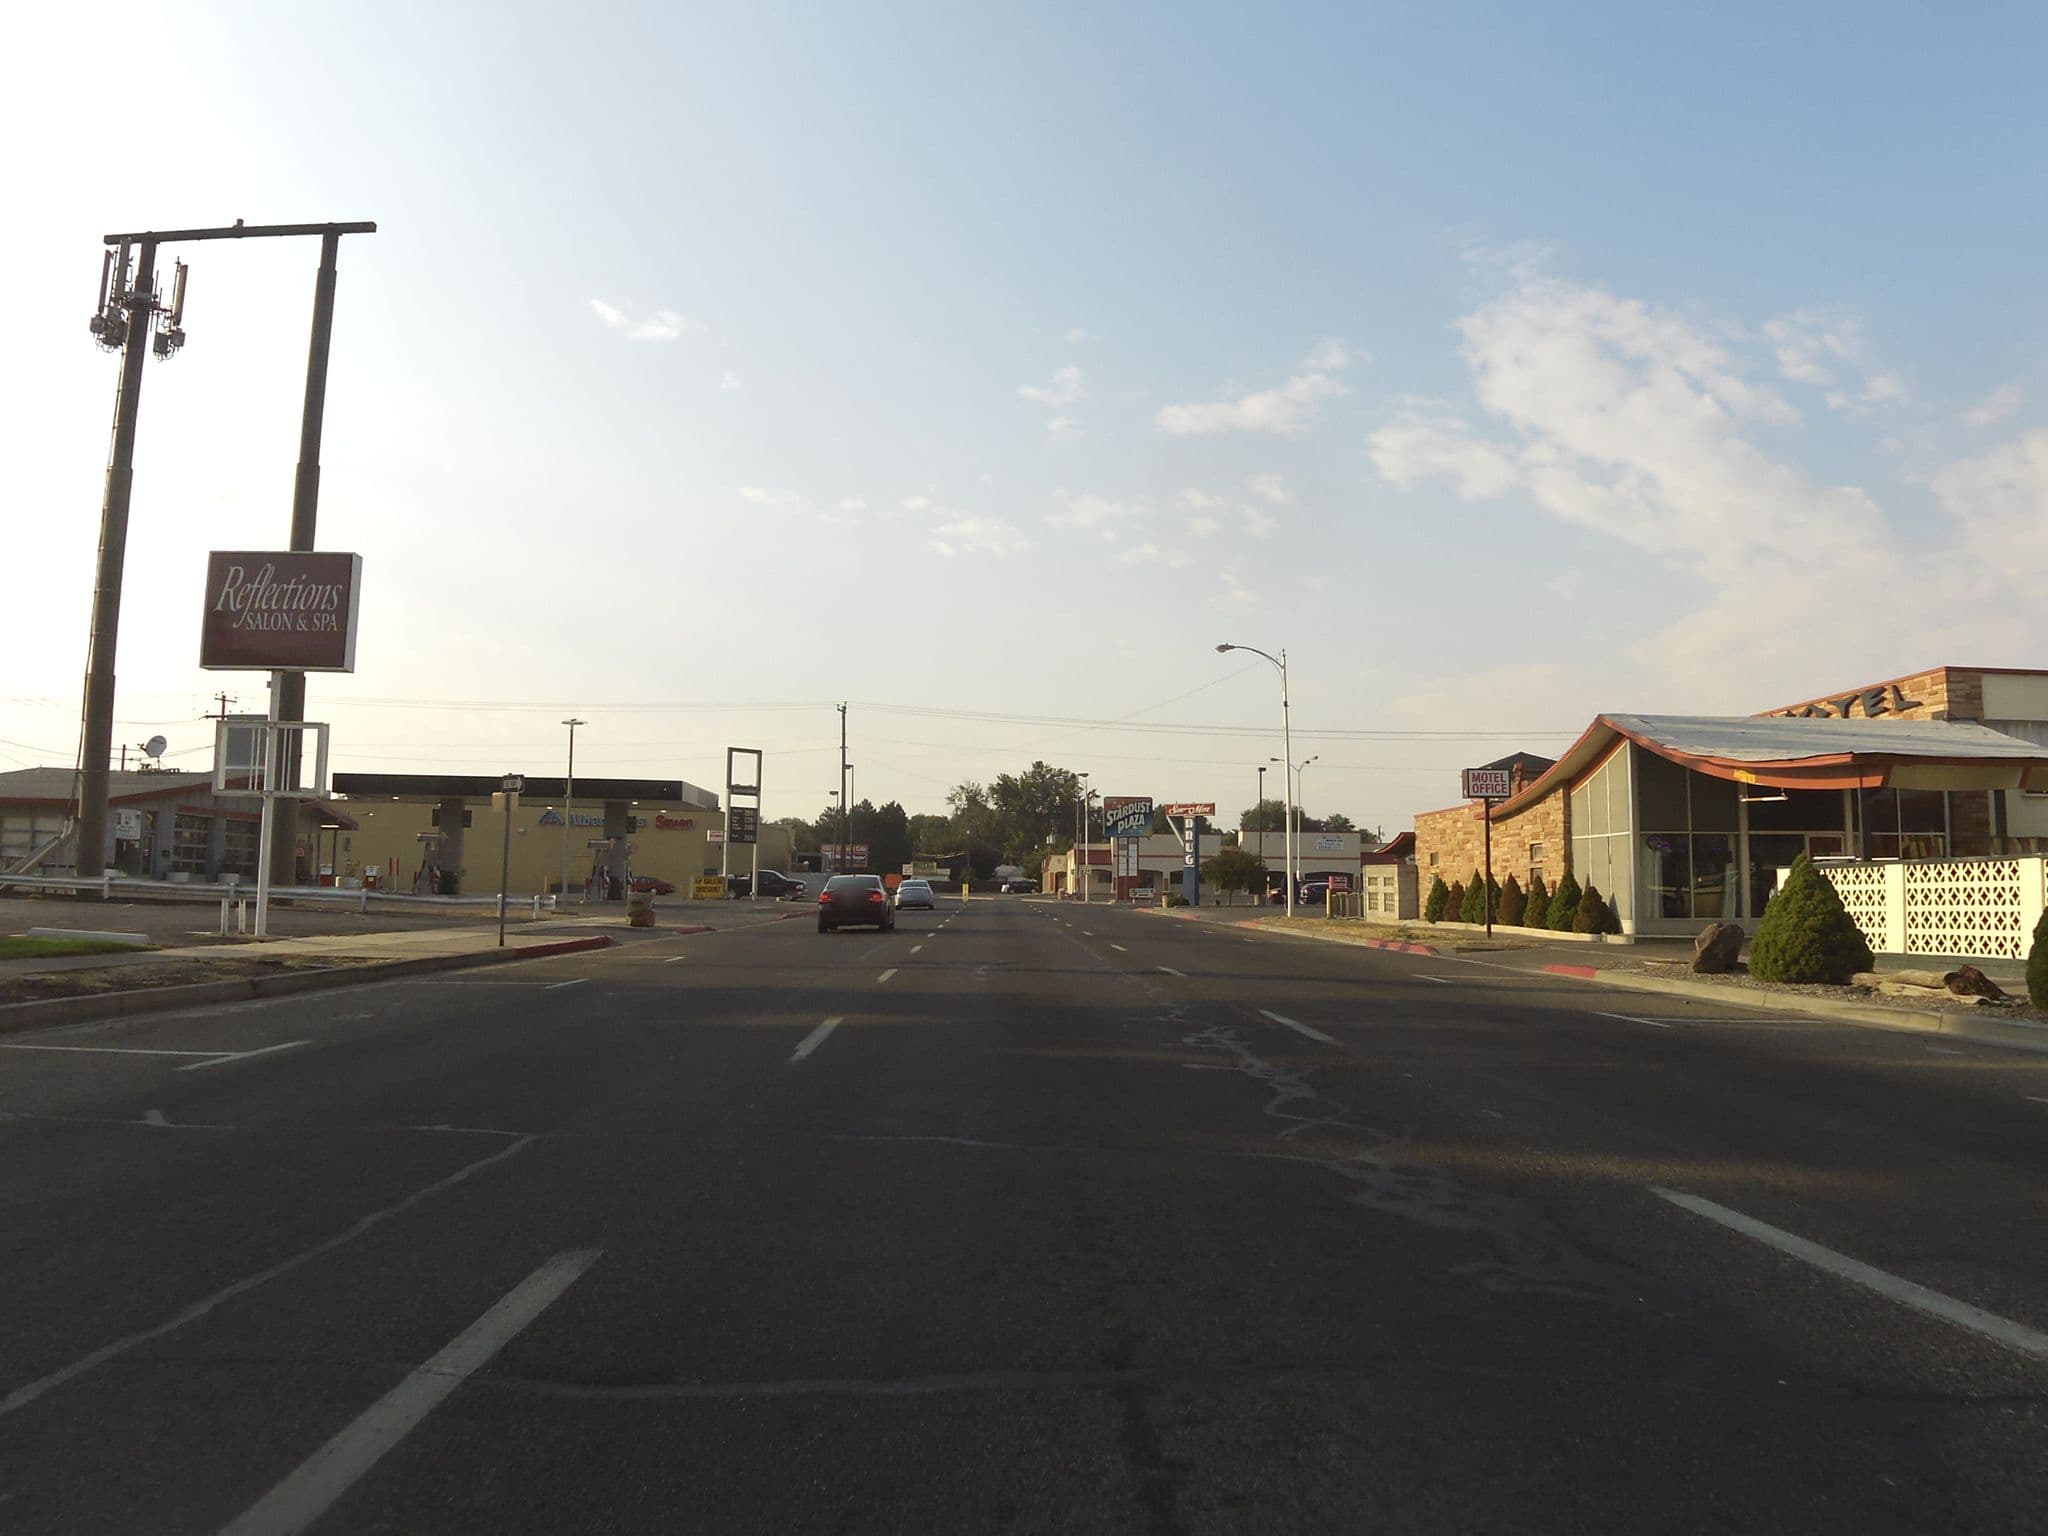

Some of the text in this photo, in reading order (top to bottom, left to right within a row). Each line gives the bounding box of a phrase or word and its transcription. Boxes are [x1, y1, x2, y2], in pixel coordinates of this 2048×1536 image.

[215, 563, 342, 628] Reflections
[246, 612, 338, 631] SALON & SPA
[1770, 684, 1921, 719] TEL
[1472, 772, 1507, 782] MOTEL
[1472, 783, 1507, 793] OFFICE
[568, 813, 647, 827] Albers
[1106, 801, 1151, 826] STARDUST
[1118, 814, 1145, 833] PLAZA
[1185, 818, 1193, 865] DRUG
